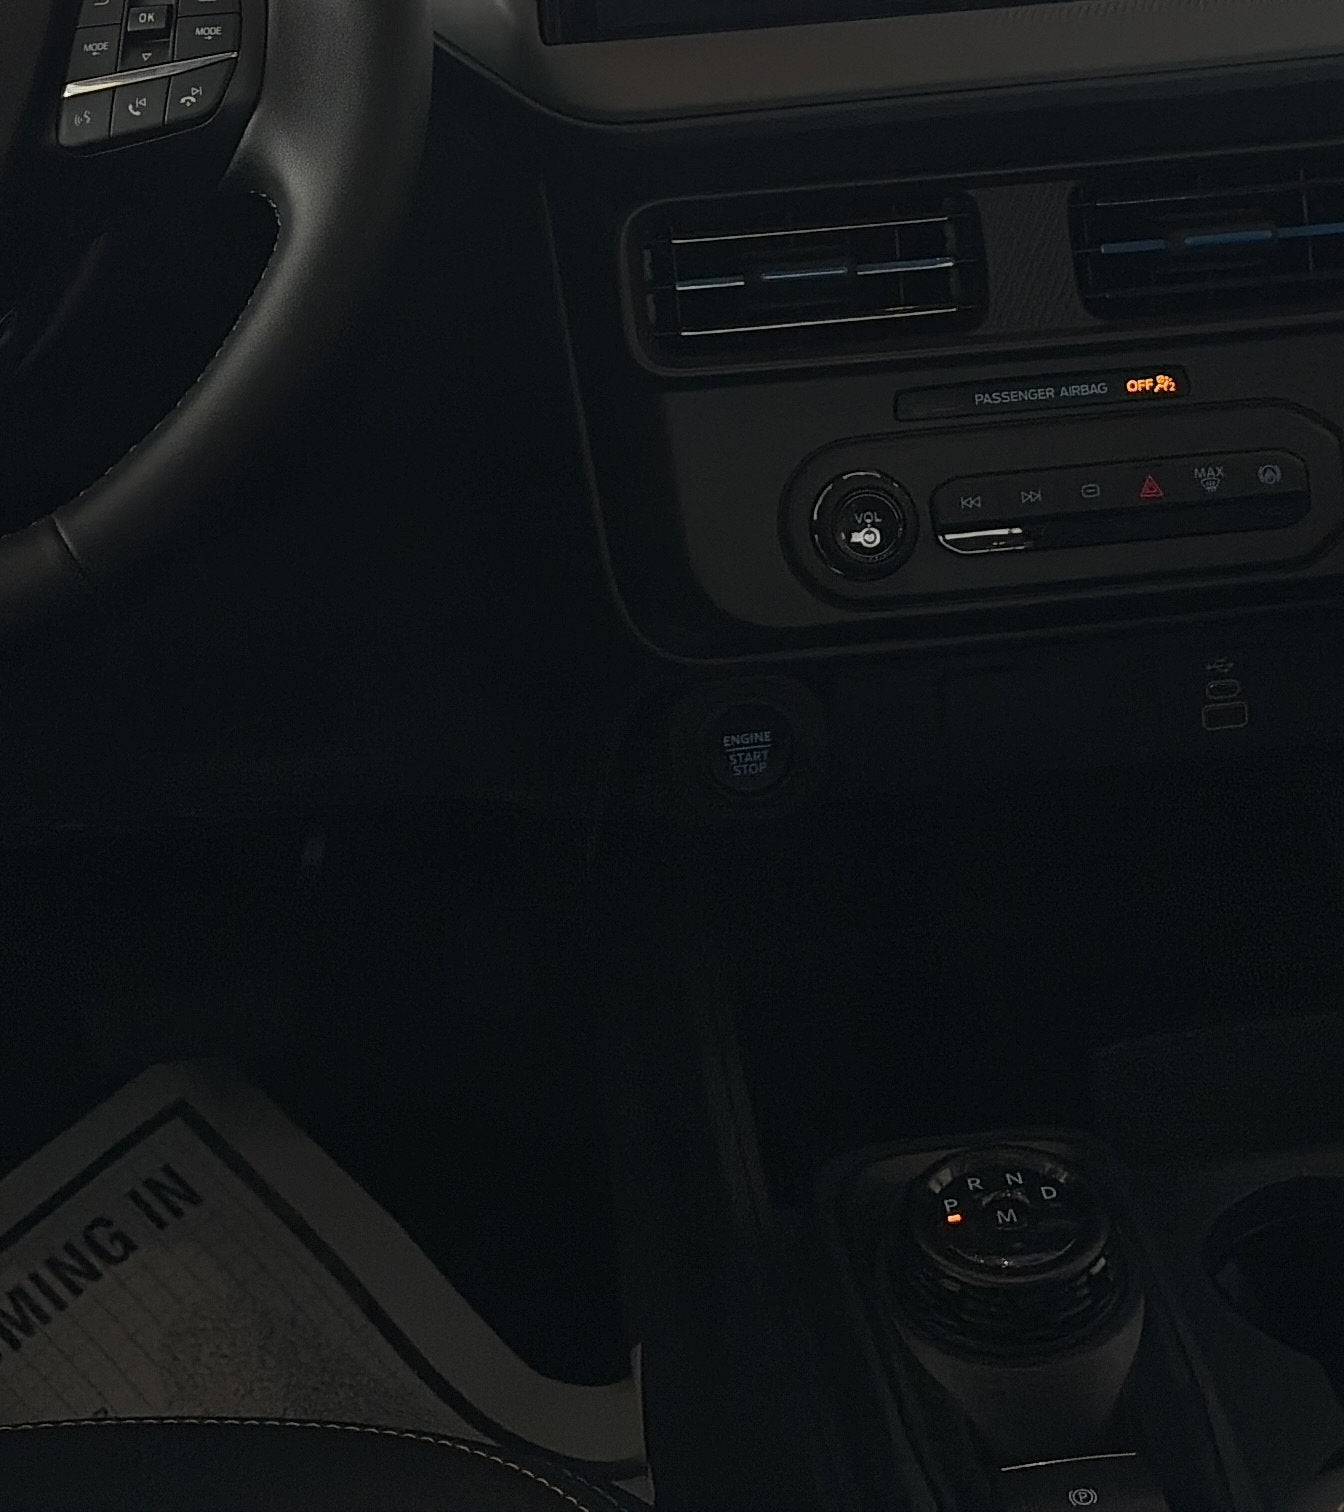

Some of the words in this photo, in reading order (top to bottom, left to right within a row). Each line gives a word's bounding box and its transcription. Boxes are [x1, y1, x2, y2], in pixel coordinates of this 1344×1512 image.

[138, 11, 155, 24] OK
[194, 24, 223, 38] MODE
[83, 41, 109, 54] MODE
[974, 387, 1055, 405] PASSENGER
[1060, 382, 1109, 398] AIRBAG
[1126, 378, 1154, 393] OFF
[1193, 465, 1224, 480] MAX
[854, 510, 882, 524] VOL
[722, 730, 773, 747] ENGINE
[729, 749, 770, 765] START
[733, 761, 769, 776] STOP
[967, 1177, 984, 1191] R
[1005, 1171, 1024, 1186] N
[128, 1163, 204, 1230] IN
[1040, 1186, 1057, 1200] D
[943, 1197, 959, 1212] P
[996, 1208, 1017, 1224] M
